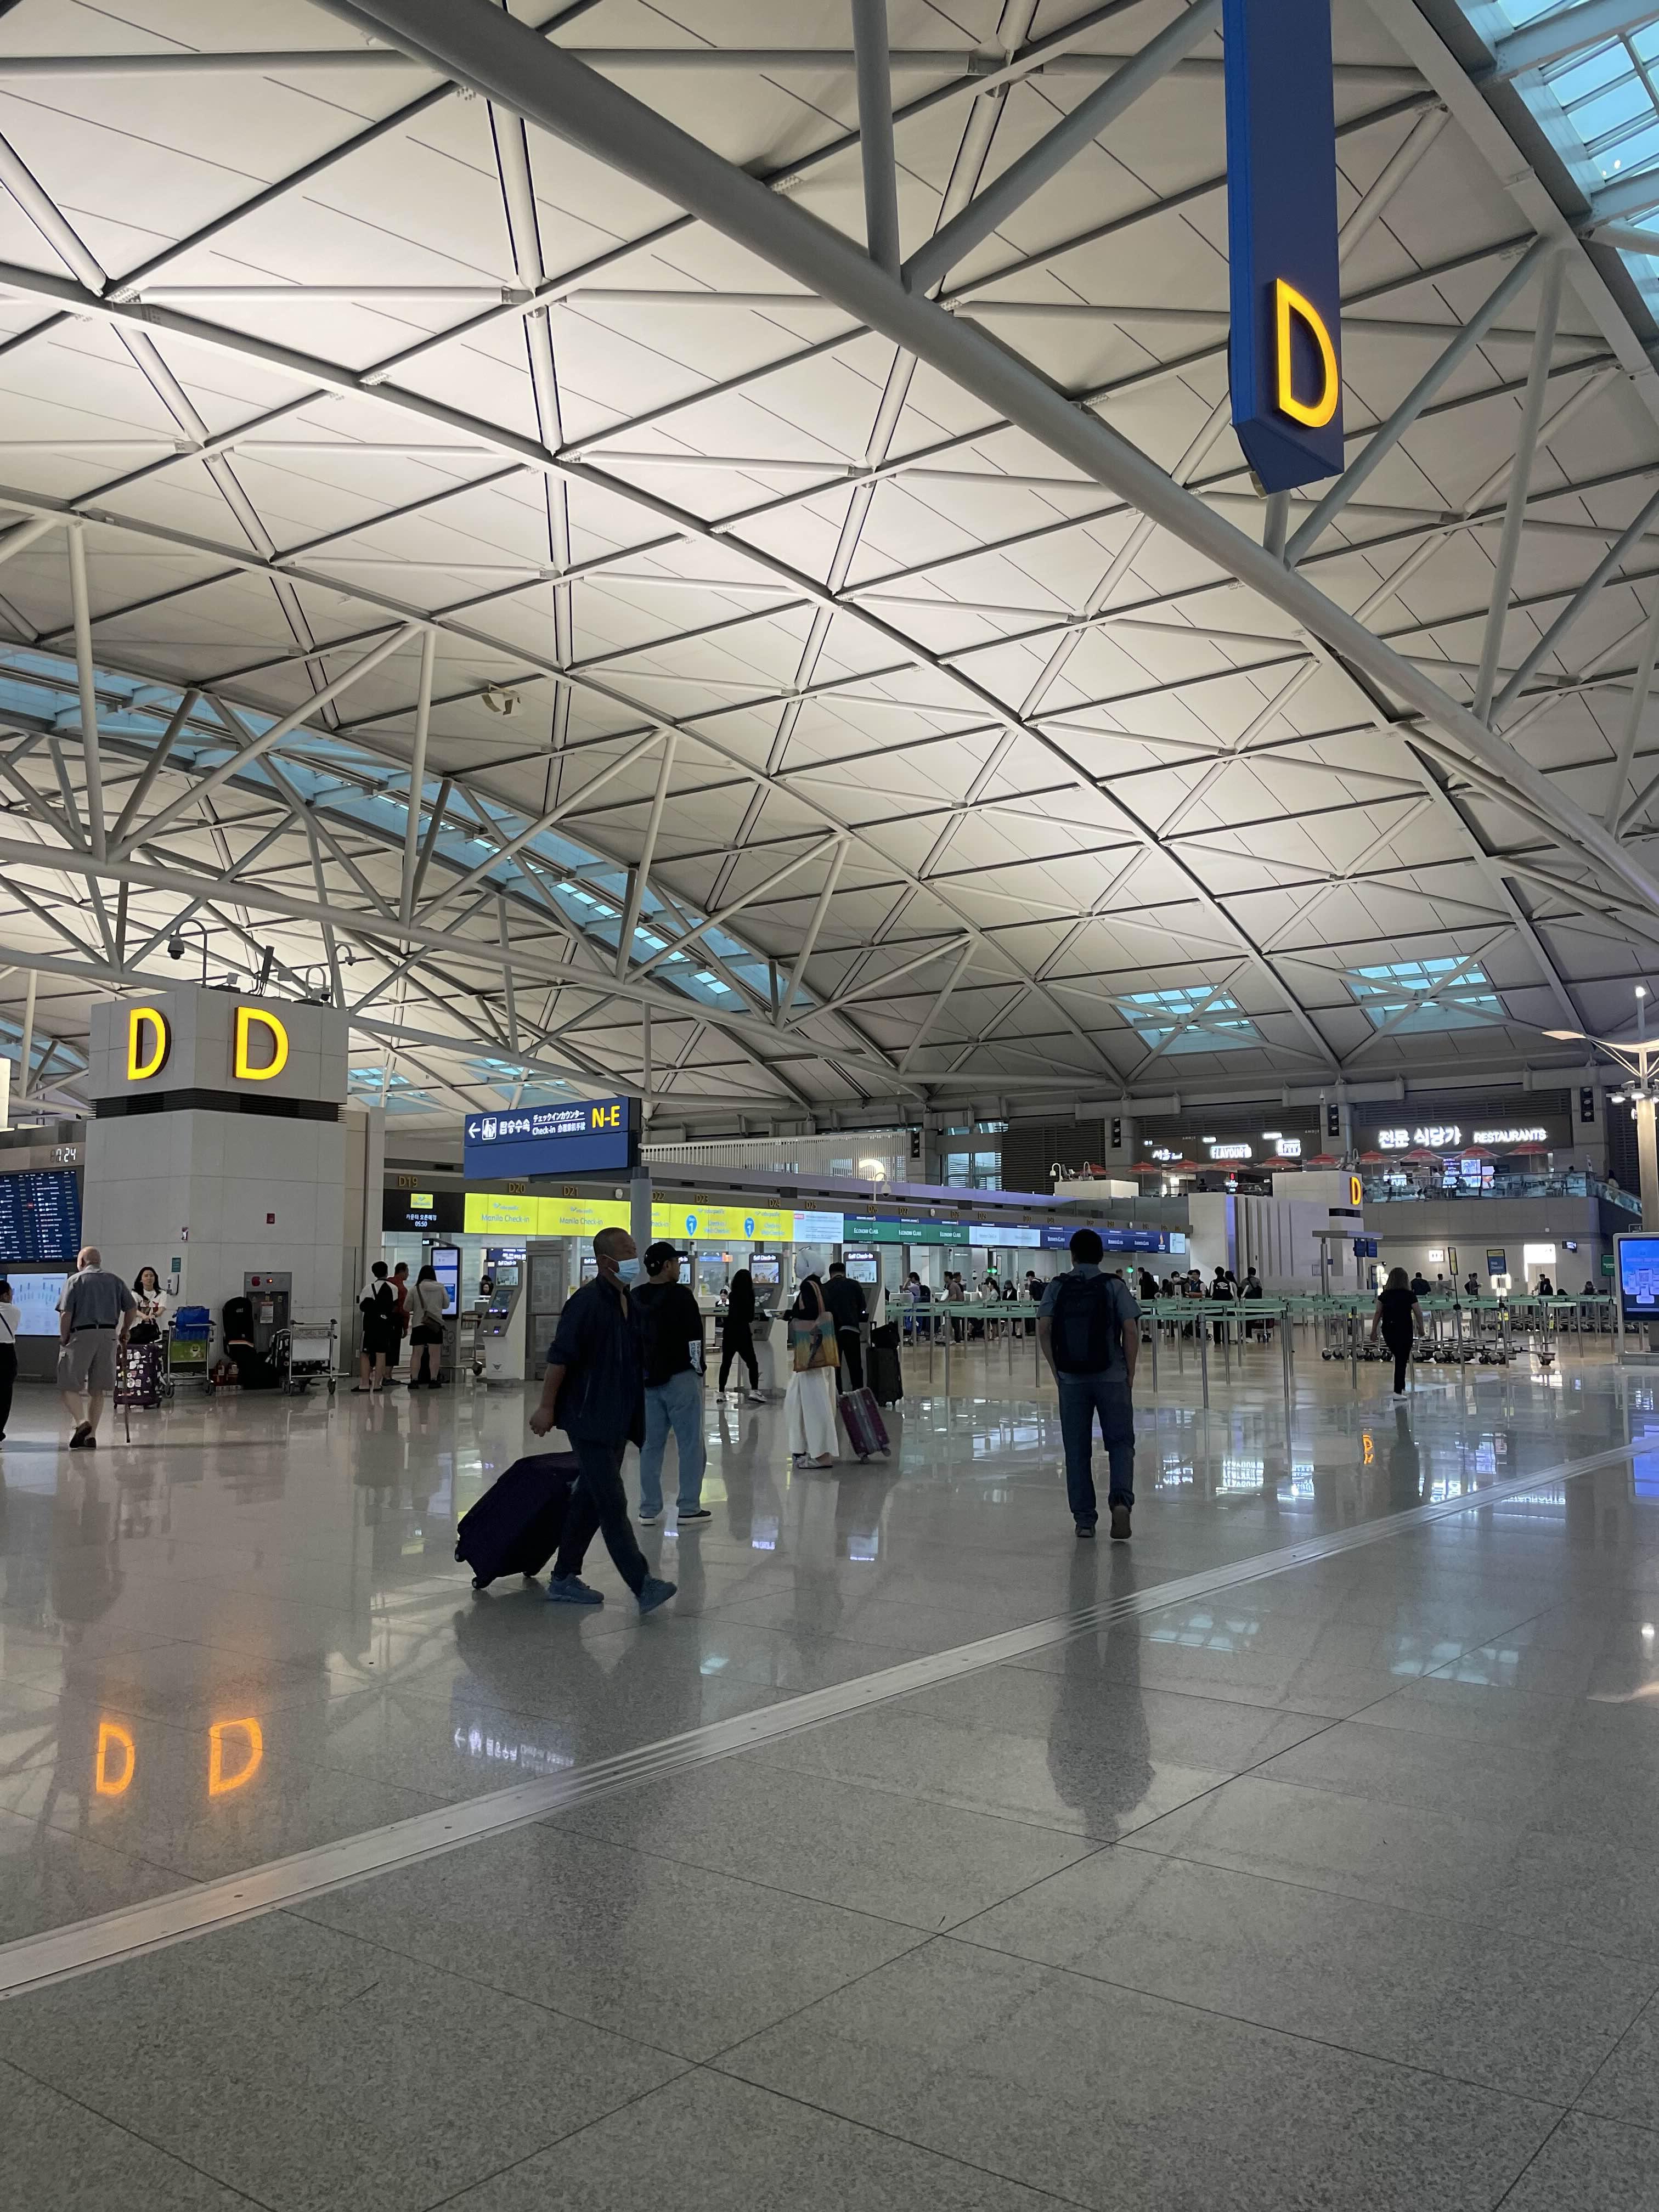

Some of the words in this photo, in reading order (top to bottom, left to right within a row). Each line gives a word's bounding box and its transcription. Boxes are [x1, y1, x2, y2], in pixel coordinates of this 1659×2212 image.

[1276, 278, 1339, 428] D
[127, 1007, 171, 1080] D
[234, 1006, 289, 1080] D
[533, 1109, 585, 1123] チェックインカウンター
[591, 1105, 620, 1128] N-E
[499, 1118, 531, 1135] 탑승수속
[532, 1125, 556, 1136] Check-in
[1378, 1128, 1410, 1149] 전문
[1413, 1125, 1462, 1147] 식당가
[1474, 1127, 1548, 1143] RESTAURANTS
[398, 1176, 418, 1187] D19
[509, 1183, 526, 1194] D20
[563, 1186, 579, 1197] D21
[1351, 1177, 1361, 1205] D
[505, 1215, 529, 1223] Check-in
